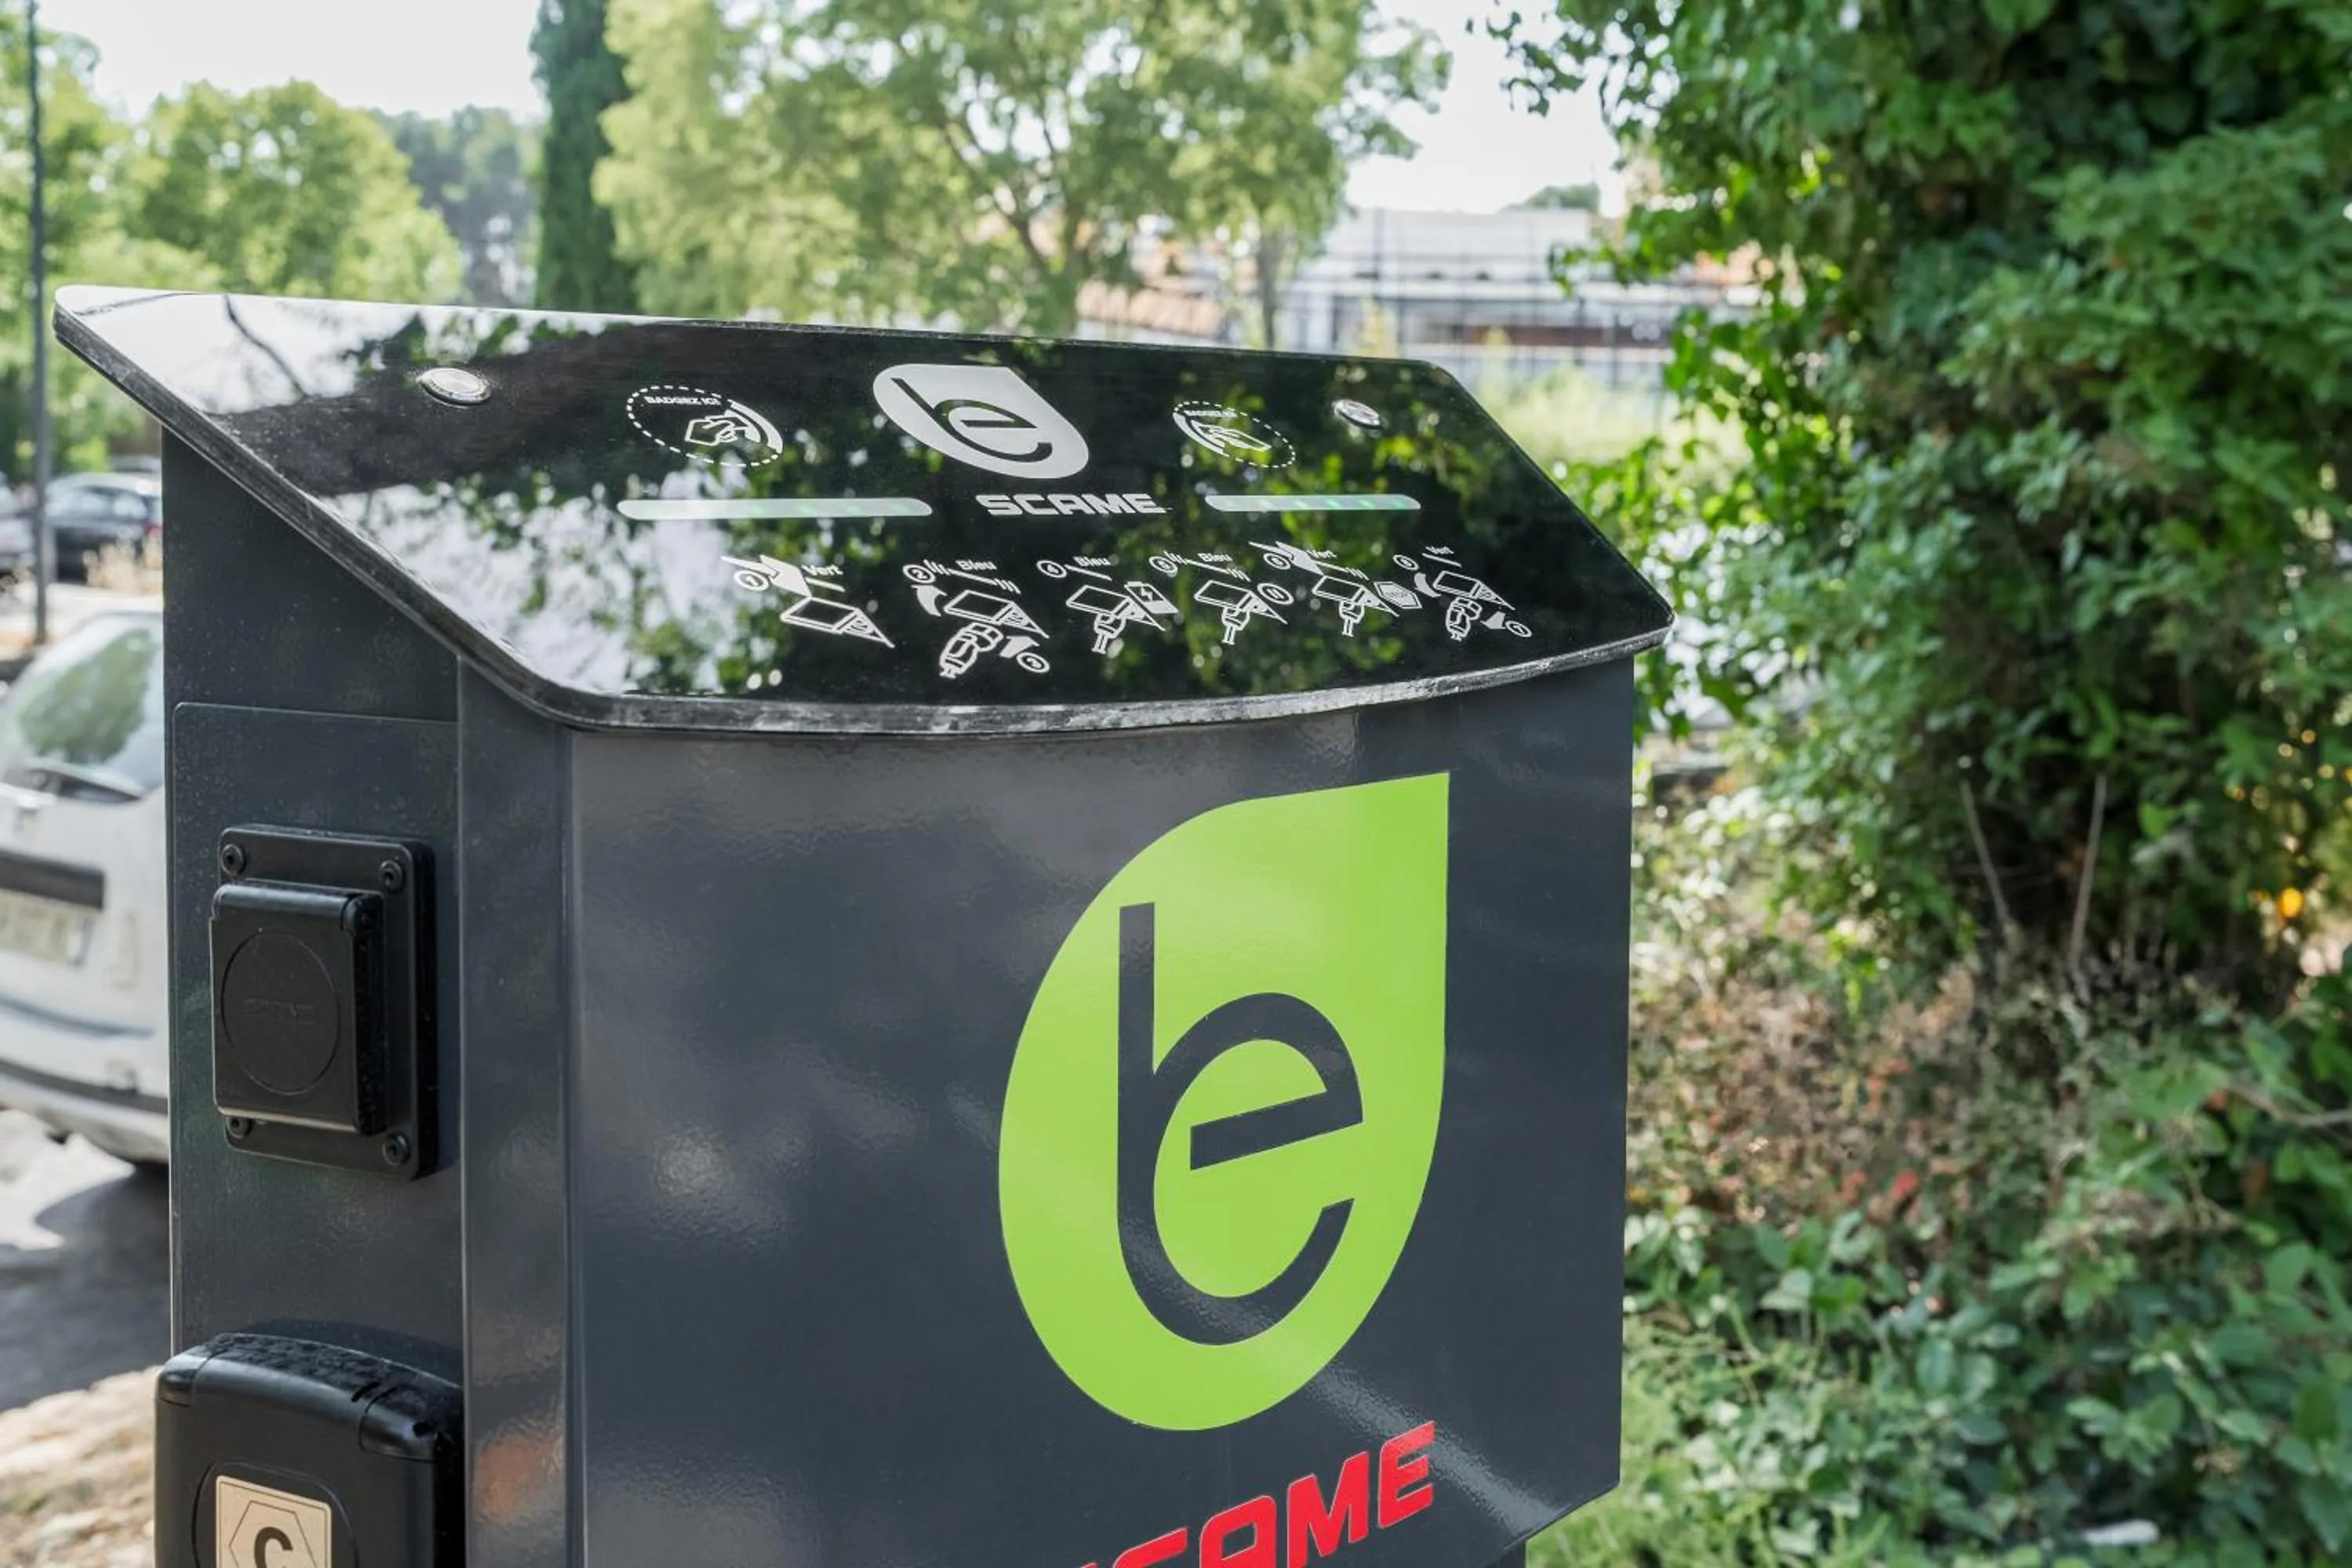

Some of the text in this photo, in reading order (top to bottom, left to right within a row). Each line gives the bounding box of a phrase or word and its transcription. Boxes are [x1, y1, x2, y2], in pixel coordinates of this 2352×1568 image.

[975, 493, 1167, 516] SCAME
[1073, 555, 1112, 568] Bleu
[1197, 553, 1233, 563] Bleu
[800, 564, 844, 577] Vert
[955, 559, 998, 571] Bleu
[1080, 1420, 1436, 1568] AME
